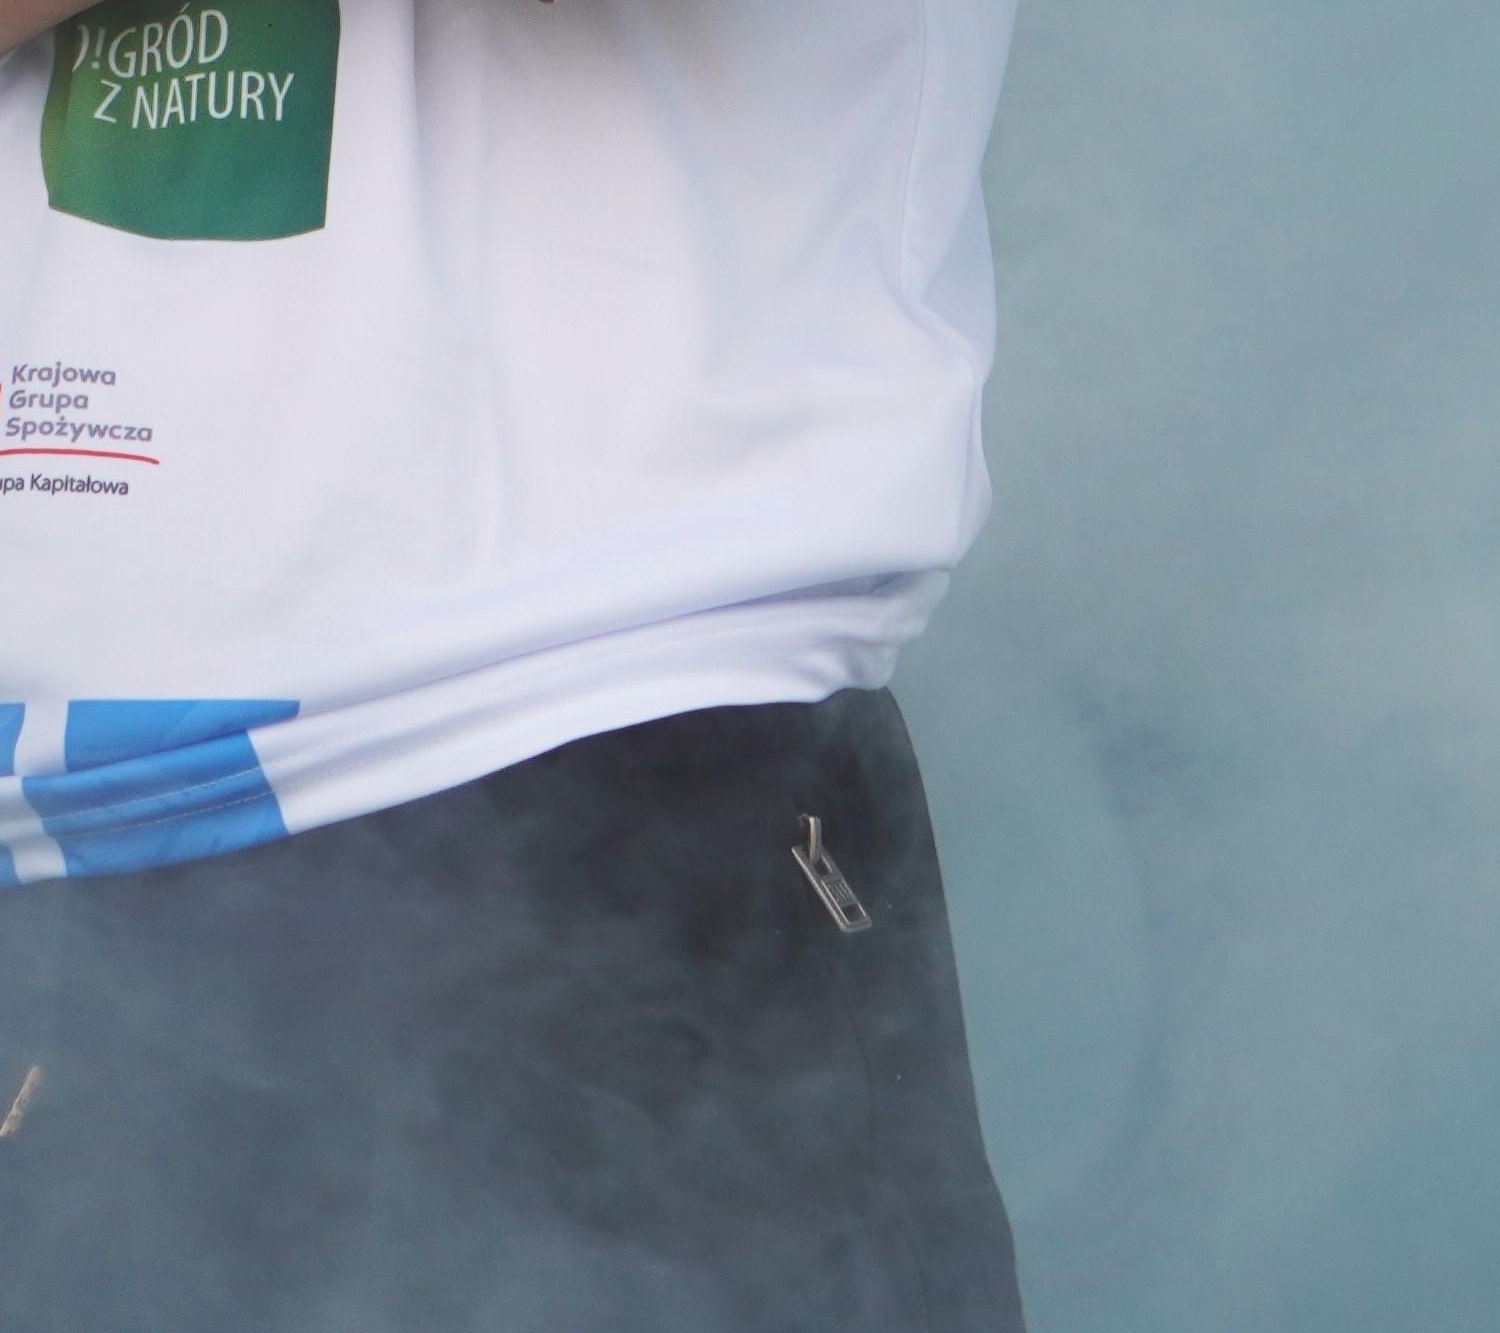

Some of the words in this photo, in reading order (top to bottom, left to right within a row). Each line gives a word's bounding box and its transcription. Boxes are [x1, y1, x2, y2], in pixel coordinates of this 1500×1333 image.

[94, 79, 122, 124] Z
[132, 70, 295, 129] NATURY
[12, 361, 116, 387] Krajowa
[9, 390, 89, 414] Grupa
[5, 416, 153, 443] Spożywcza
